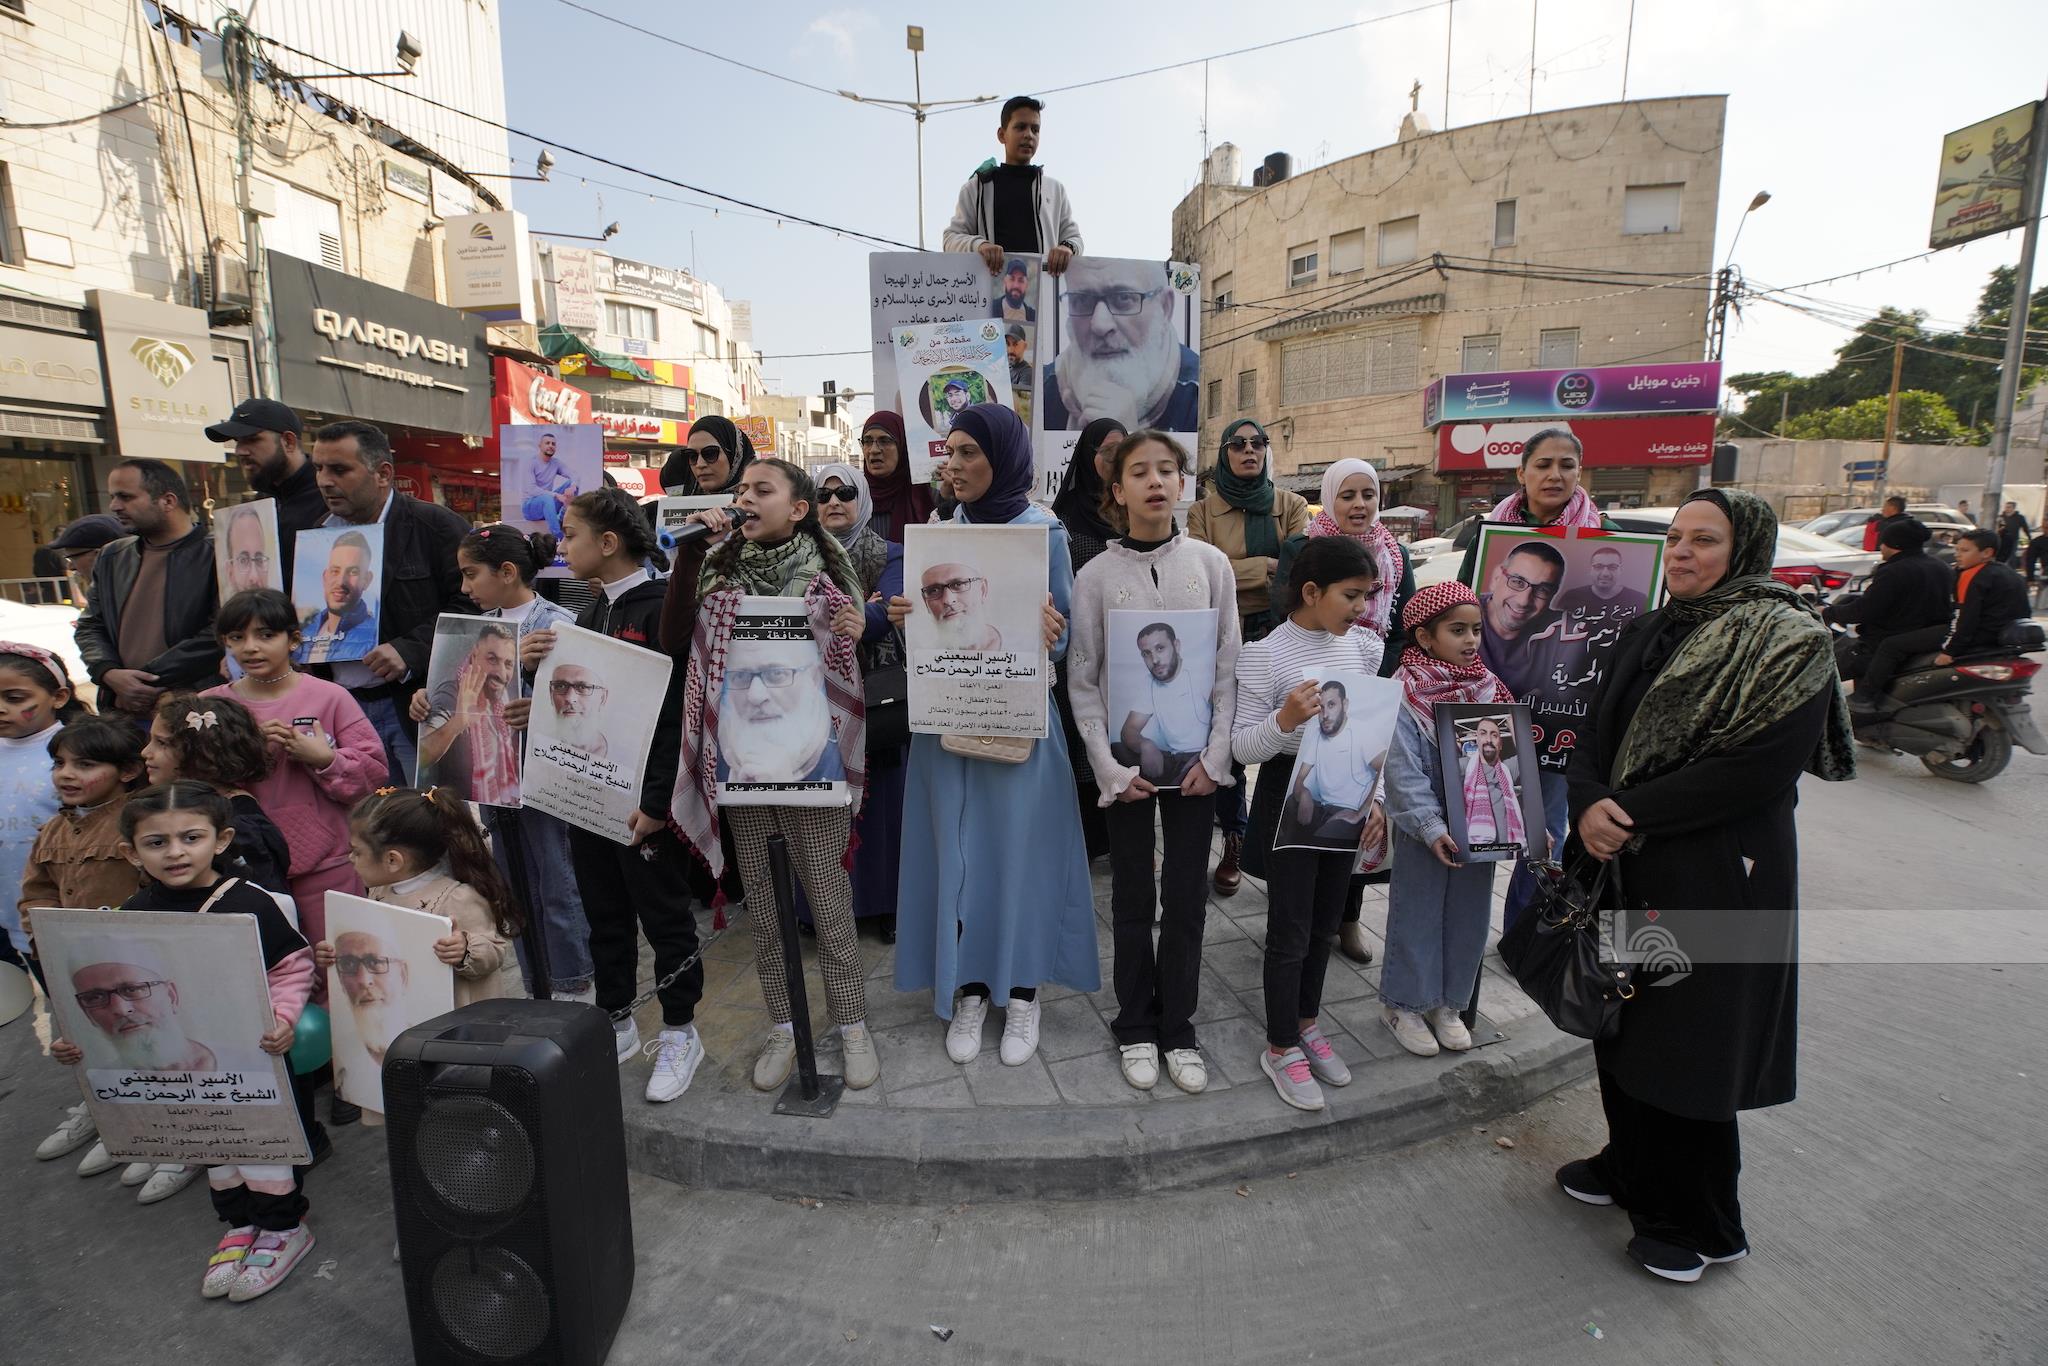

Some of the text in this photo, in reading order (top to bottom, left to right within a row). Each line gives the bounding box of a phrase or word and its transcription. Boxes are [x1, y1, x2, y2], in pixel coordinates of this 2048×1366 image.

[884, 271, 976, 289] الأسير جمال أبو الهيجا
[873, 290, 987, 309] و أبنائه الأسرى عبدالسلام و
[313, 308, 468, 368] QARQASH
[364, 362, 434, 387] BOUTIQUE
[1628, 374, 1701, 391] جنين موبايل
[130, 396, 209, 417] STELLA
[1647, 442, 1708, 454] جنين موبايل
[731, 630, 808, 641] محافظة جنين
[934, 651, 1017, 664] الأسير السبعيني
[916, 663, 1036, 679] الشيخ عبد الرحمن صلاح
[1551, 658, 1603, 691] الحرية
[1537, 698, 1588, 717] لأسير
[549, 743, 618, 773] الأسير السبعيني
[1540, 753, 1567, 768] أبو
[533, 747, 632, 791] الشيخ عبد الرحمن صلاح
[119, 1072, 244, 1087] الأسير السبعيني
[96, 1087, 277, 1103] الشيخ عبد الرحمن صلاح
